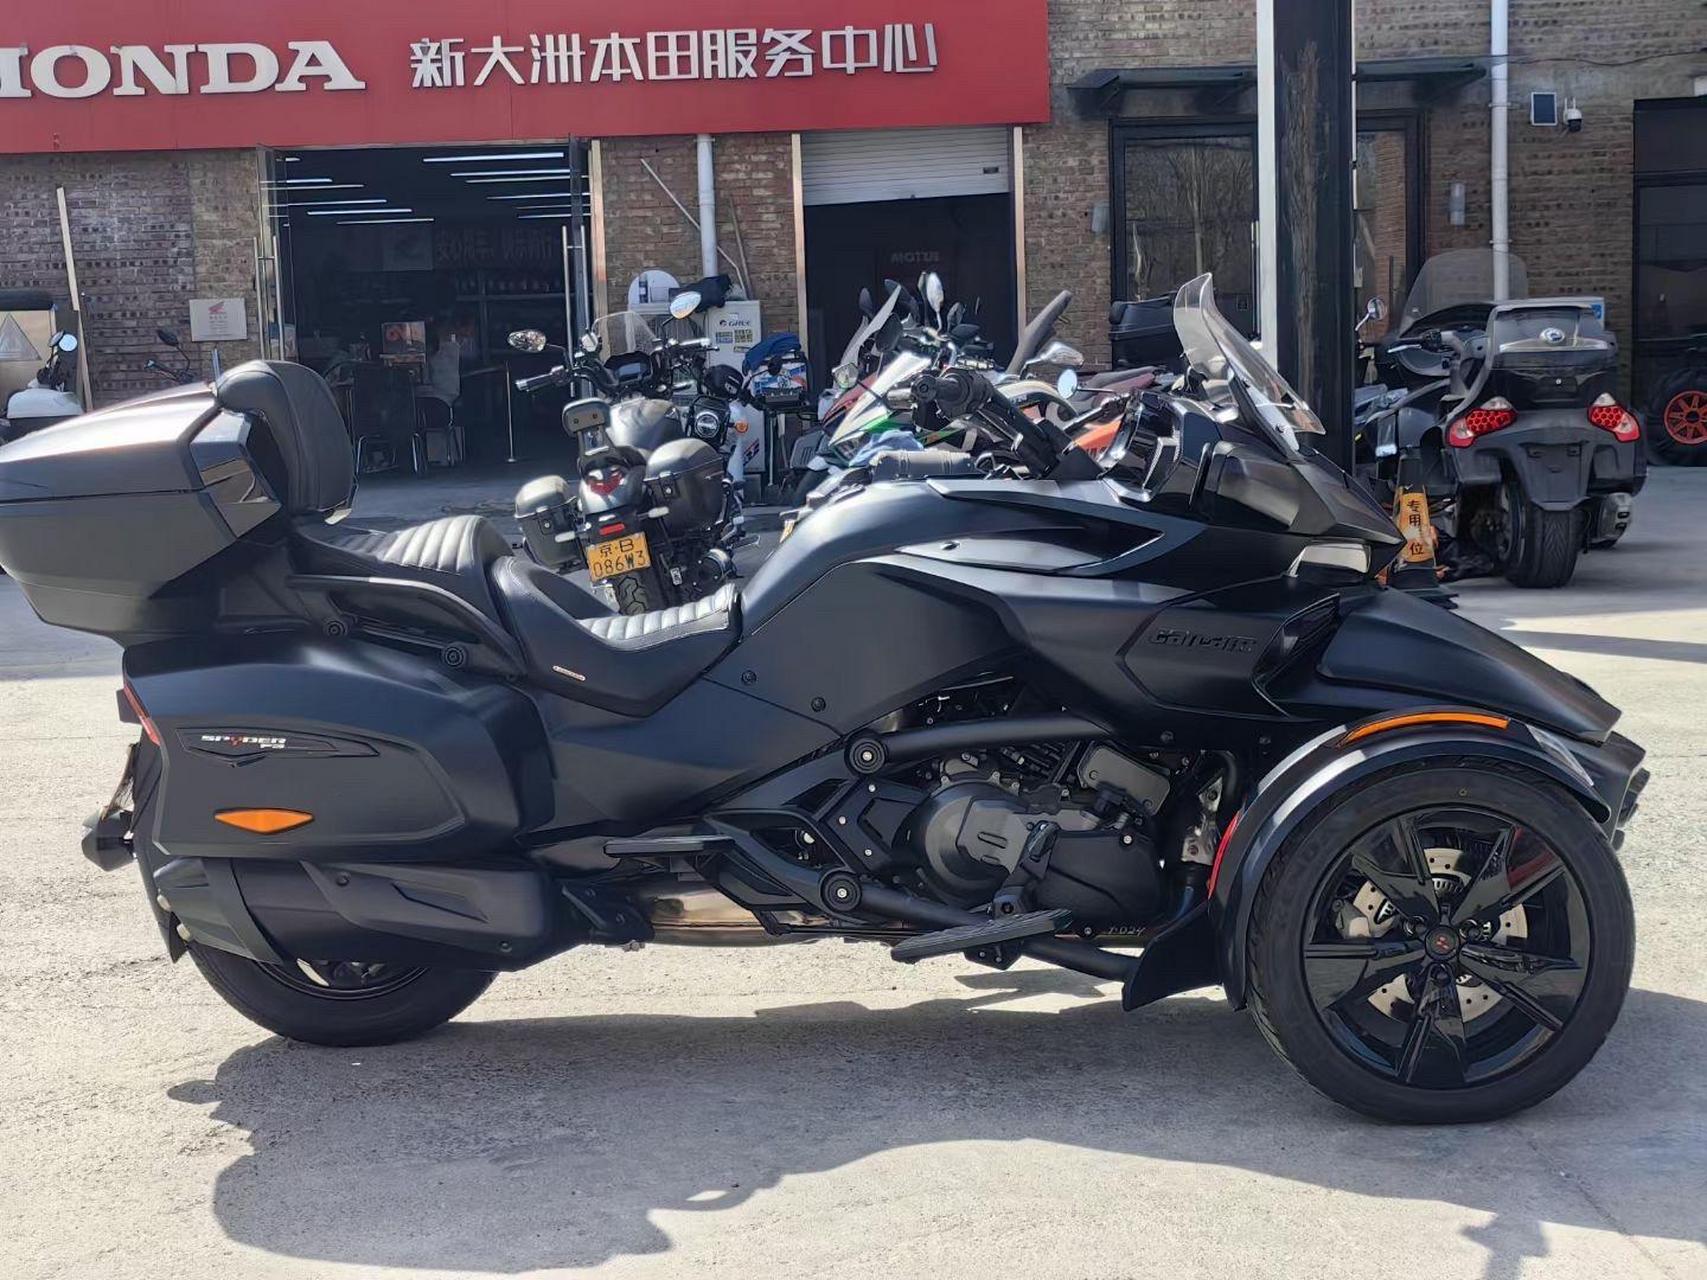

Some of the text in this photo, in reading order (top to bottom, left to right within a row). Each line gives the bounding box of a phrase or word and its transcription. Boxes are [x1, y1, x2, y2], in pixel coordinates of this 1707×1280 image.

[410, 21, 937, 88] 新大洲本田服务中心
